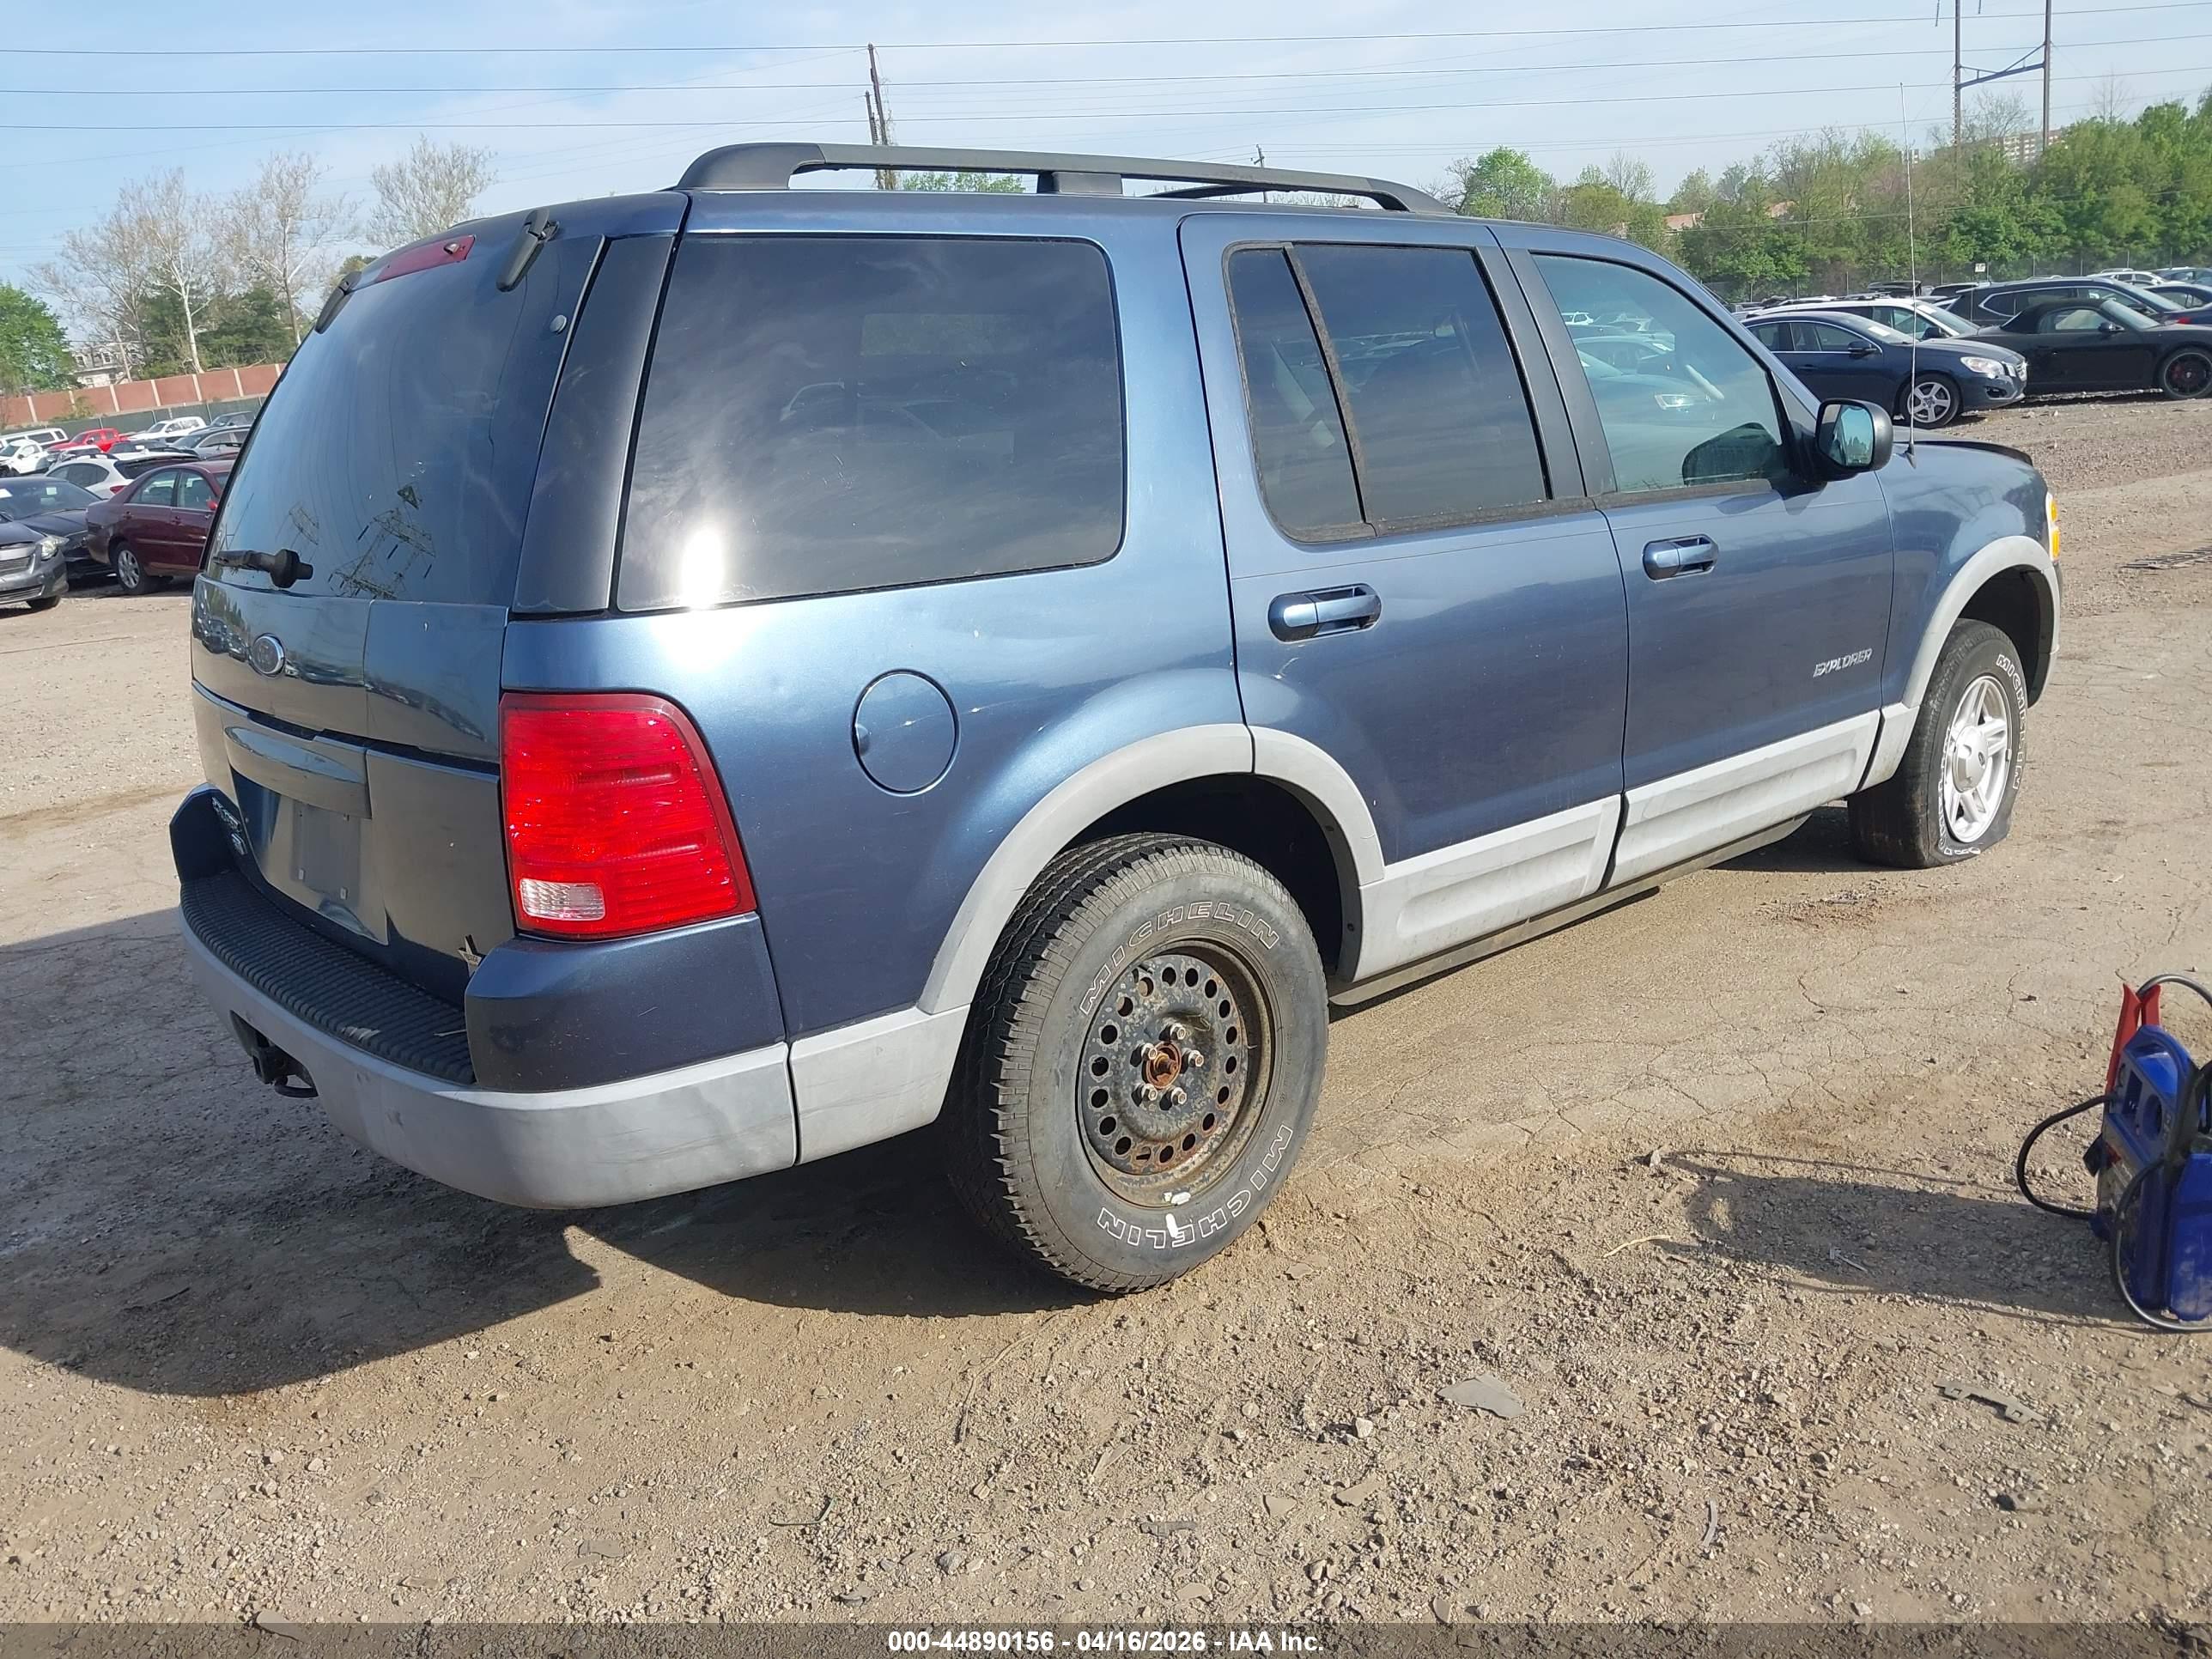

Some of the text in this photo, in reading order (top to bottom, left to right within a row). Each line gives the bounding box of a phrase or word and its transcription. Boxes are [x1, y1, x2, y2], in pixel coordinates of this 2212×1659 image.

[1812, 647, 1873, 678] EXPLORER
[1996, 653, 2027, 790] MICHELIN
[1079, 901, 1280, 1016] MICHELIN
[1097, 1124, 1294, 1249] MICHELIN
